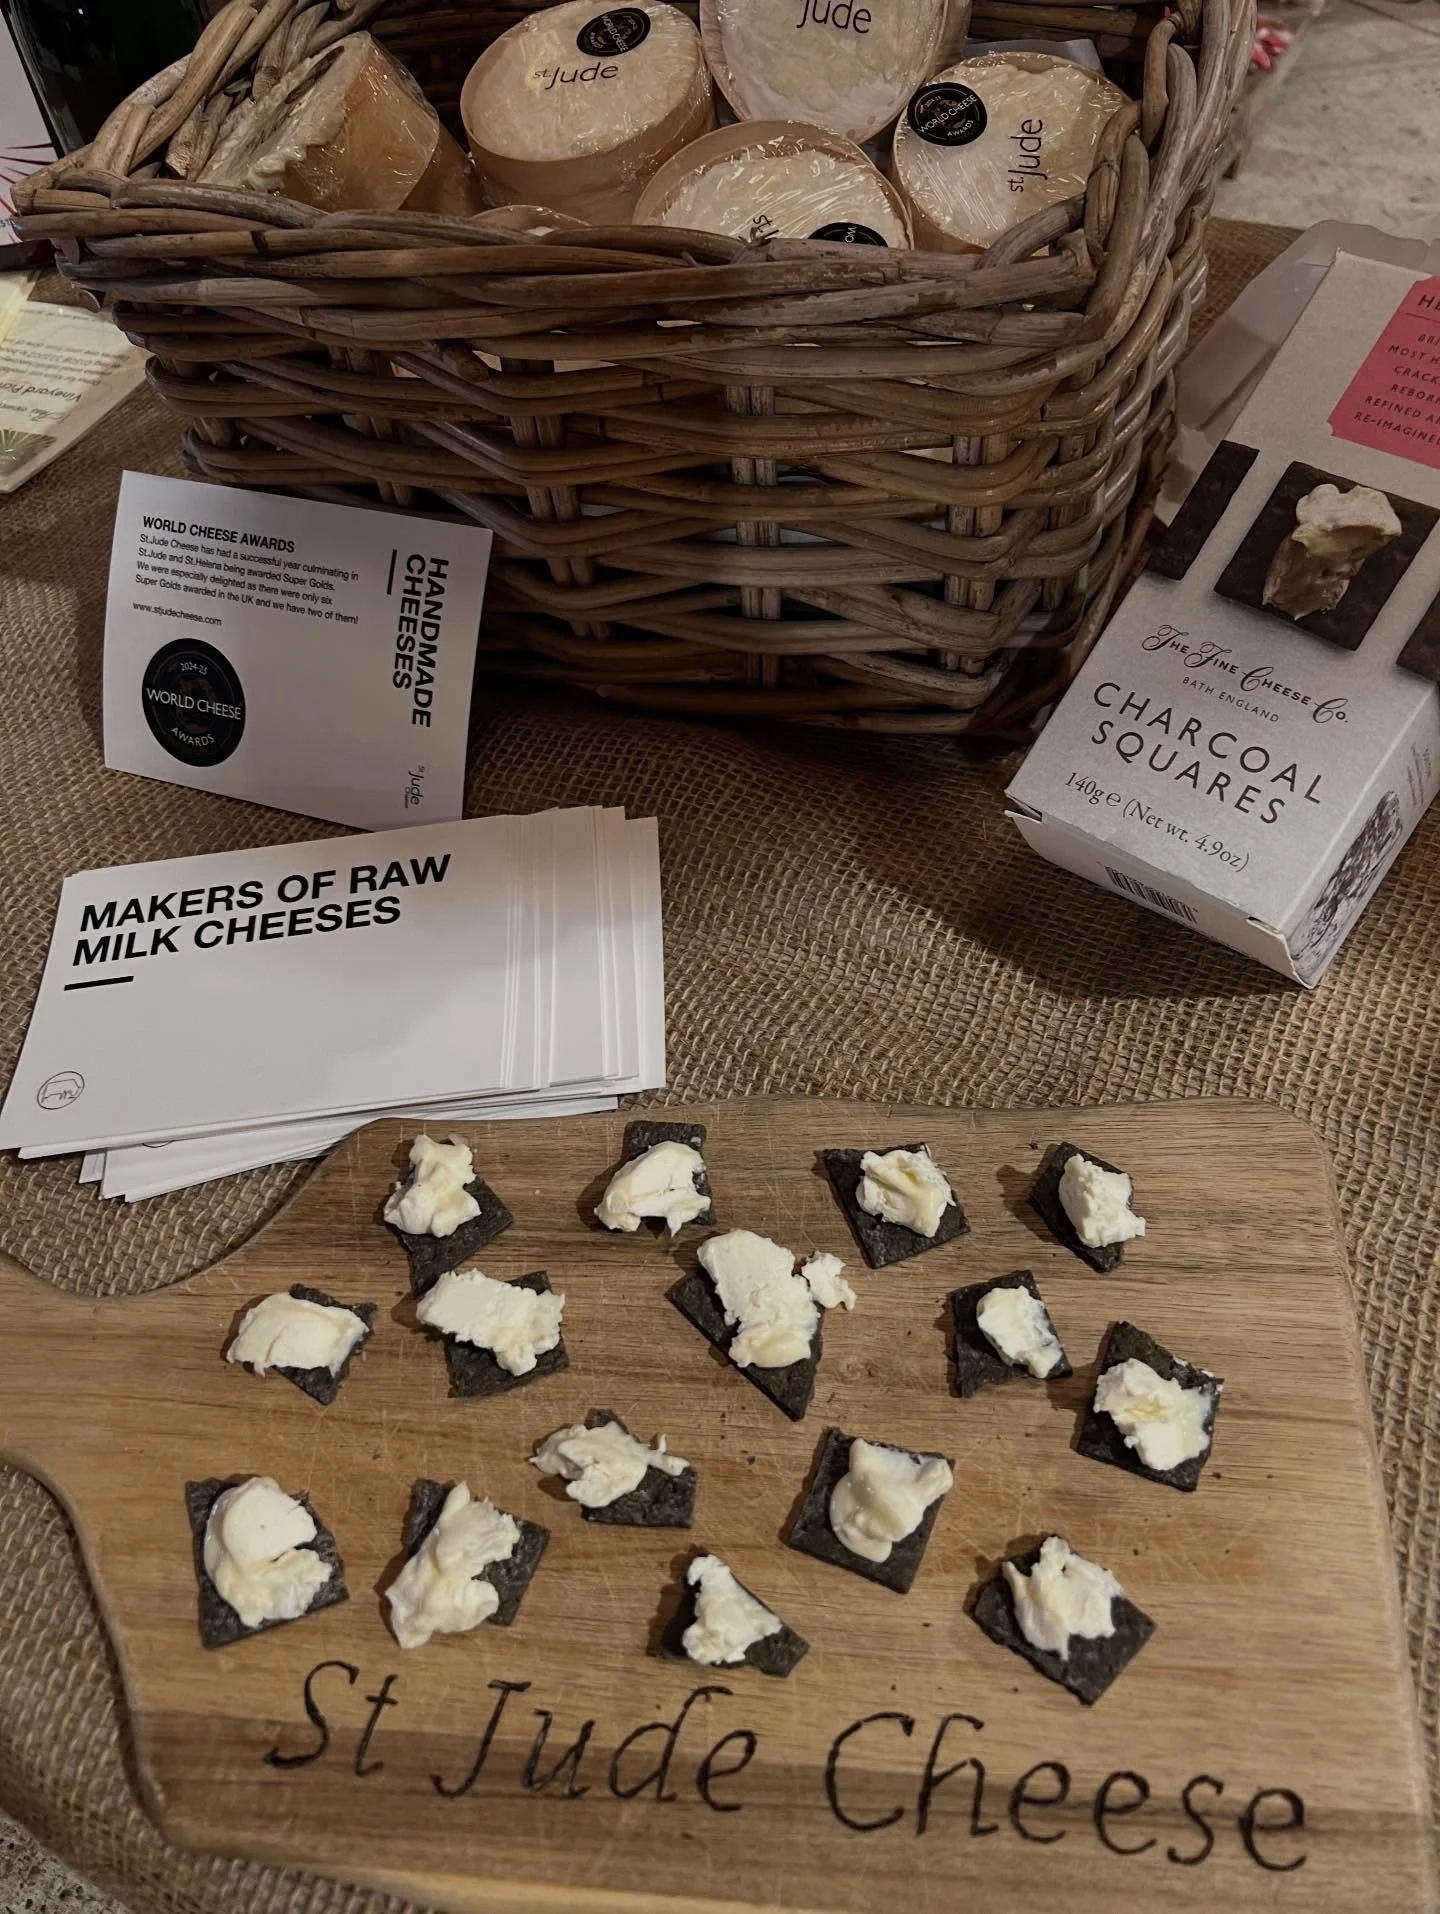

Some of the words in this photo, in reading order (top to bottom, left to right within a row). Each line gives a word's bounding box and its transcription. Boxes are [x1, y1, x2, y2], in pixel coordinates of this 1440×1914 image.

[916, 113, 950, 134] WORLD
[948, 94, 978, 117] CHEESE
[947, 118, 974, 137] AWARDS
[1388, 344, 1425, 361] MOST
[1364, 394, 1422, 419] REFINED
[142, 515, 188, 534] WORLD
[189, 523, 240, 544] CHEESE
[240, 532, 296, 554] AWARDS
[136, 560, 150, 571] We
[151, 564, 170, 575] were
[170, 568, 209, 584] especially
[209, 574, 246, 588] delighted
[246, 582, 257, 591] as
[258, 583, 279, 595] there
[280, 588, 301, 599] were
[302, 591, 320, 605] only
[320, 595, 334, 606] six
[168, 553, 184, 564] and
[223, 562, 246, 577] being
[246, 567, 282, 581] awarded
[283, 572, 308, 586] Super
[309, 578, 336, 592] Golds.
[170, 538, 200, 553] Cheese
[200, 544, 215, 555] has
[216, 547, 232, 558] had
[240, 552, 282, 568] successful
[283, 560, 302, 571] year
[302, 562, 350, 582] culminating
[350, 570, 360, 581] in
[132, 601, 223, 627] www.stjudecheese.com
[135, 573, 159, 586] Super
[159, 578, 183, 591] Golds
[183, 584, 217, 597] awarded
[218, 590, 226, 600] in
[226, 591, 240, 603] the
[241, 593, 255, 605] UK
[255, 597, 272, 608] and
[272, 601, 285, 610] we
[286, 602, 306, 615] have
[307, 607, 324, 618] two
[324, 610, 334, 620] of
[335, 611, 359, 625] them!
[392, 553, 427, 690] CHEESES
[411, 556, 450, 729] HANDMADE
[146, 686, 196, 710] WORLD
[196, 699, 242, 721] CHEESE
[1182, 676, 1215, 696] BATH
[1218, 690, 1280, 723] ENGLAND
[170, 726, 215, 748] AWARDS
[1093, 681, 1323, 805] CHARCOAL
[1090, 719, 1286, 825] SQUARES
[1122, 798, 1164, 831] (Net
[1165, 823, 1189, 844] wt.
[1194, 833, 1251, 874] 4.9oz)
[80, 879, 264, 933] MAKERS
[276, 869, 338, 905] OF
[348, 853, 452, 895] RAW
[71, 924, 181, 967] MILK
[193, 895, 402, 950] CHEESES
[262, 1659, 400, 1778] St
[429, 1678, 760, 1813] Jude
[823, 1710, 1308, 1874] Cheese
